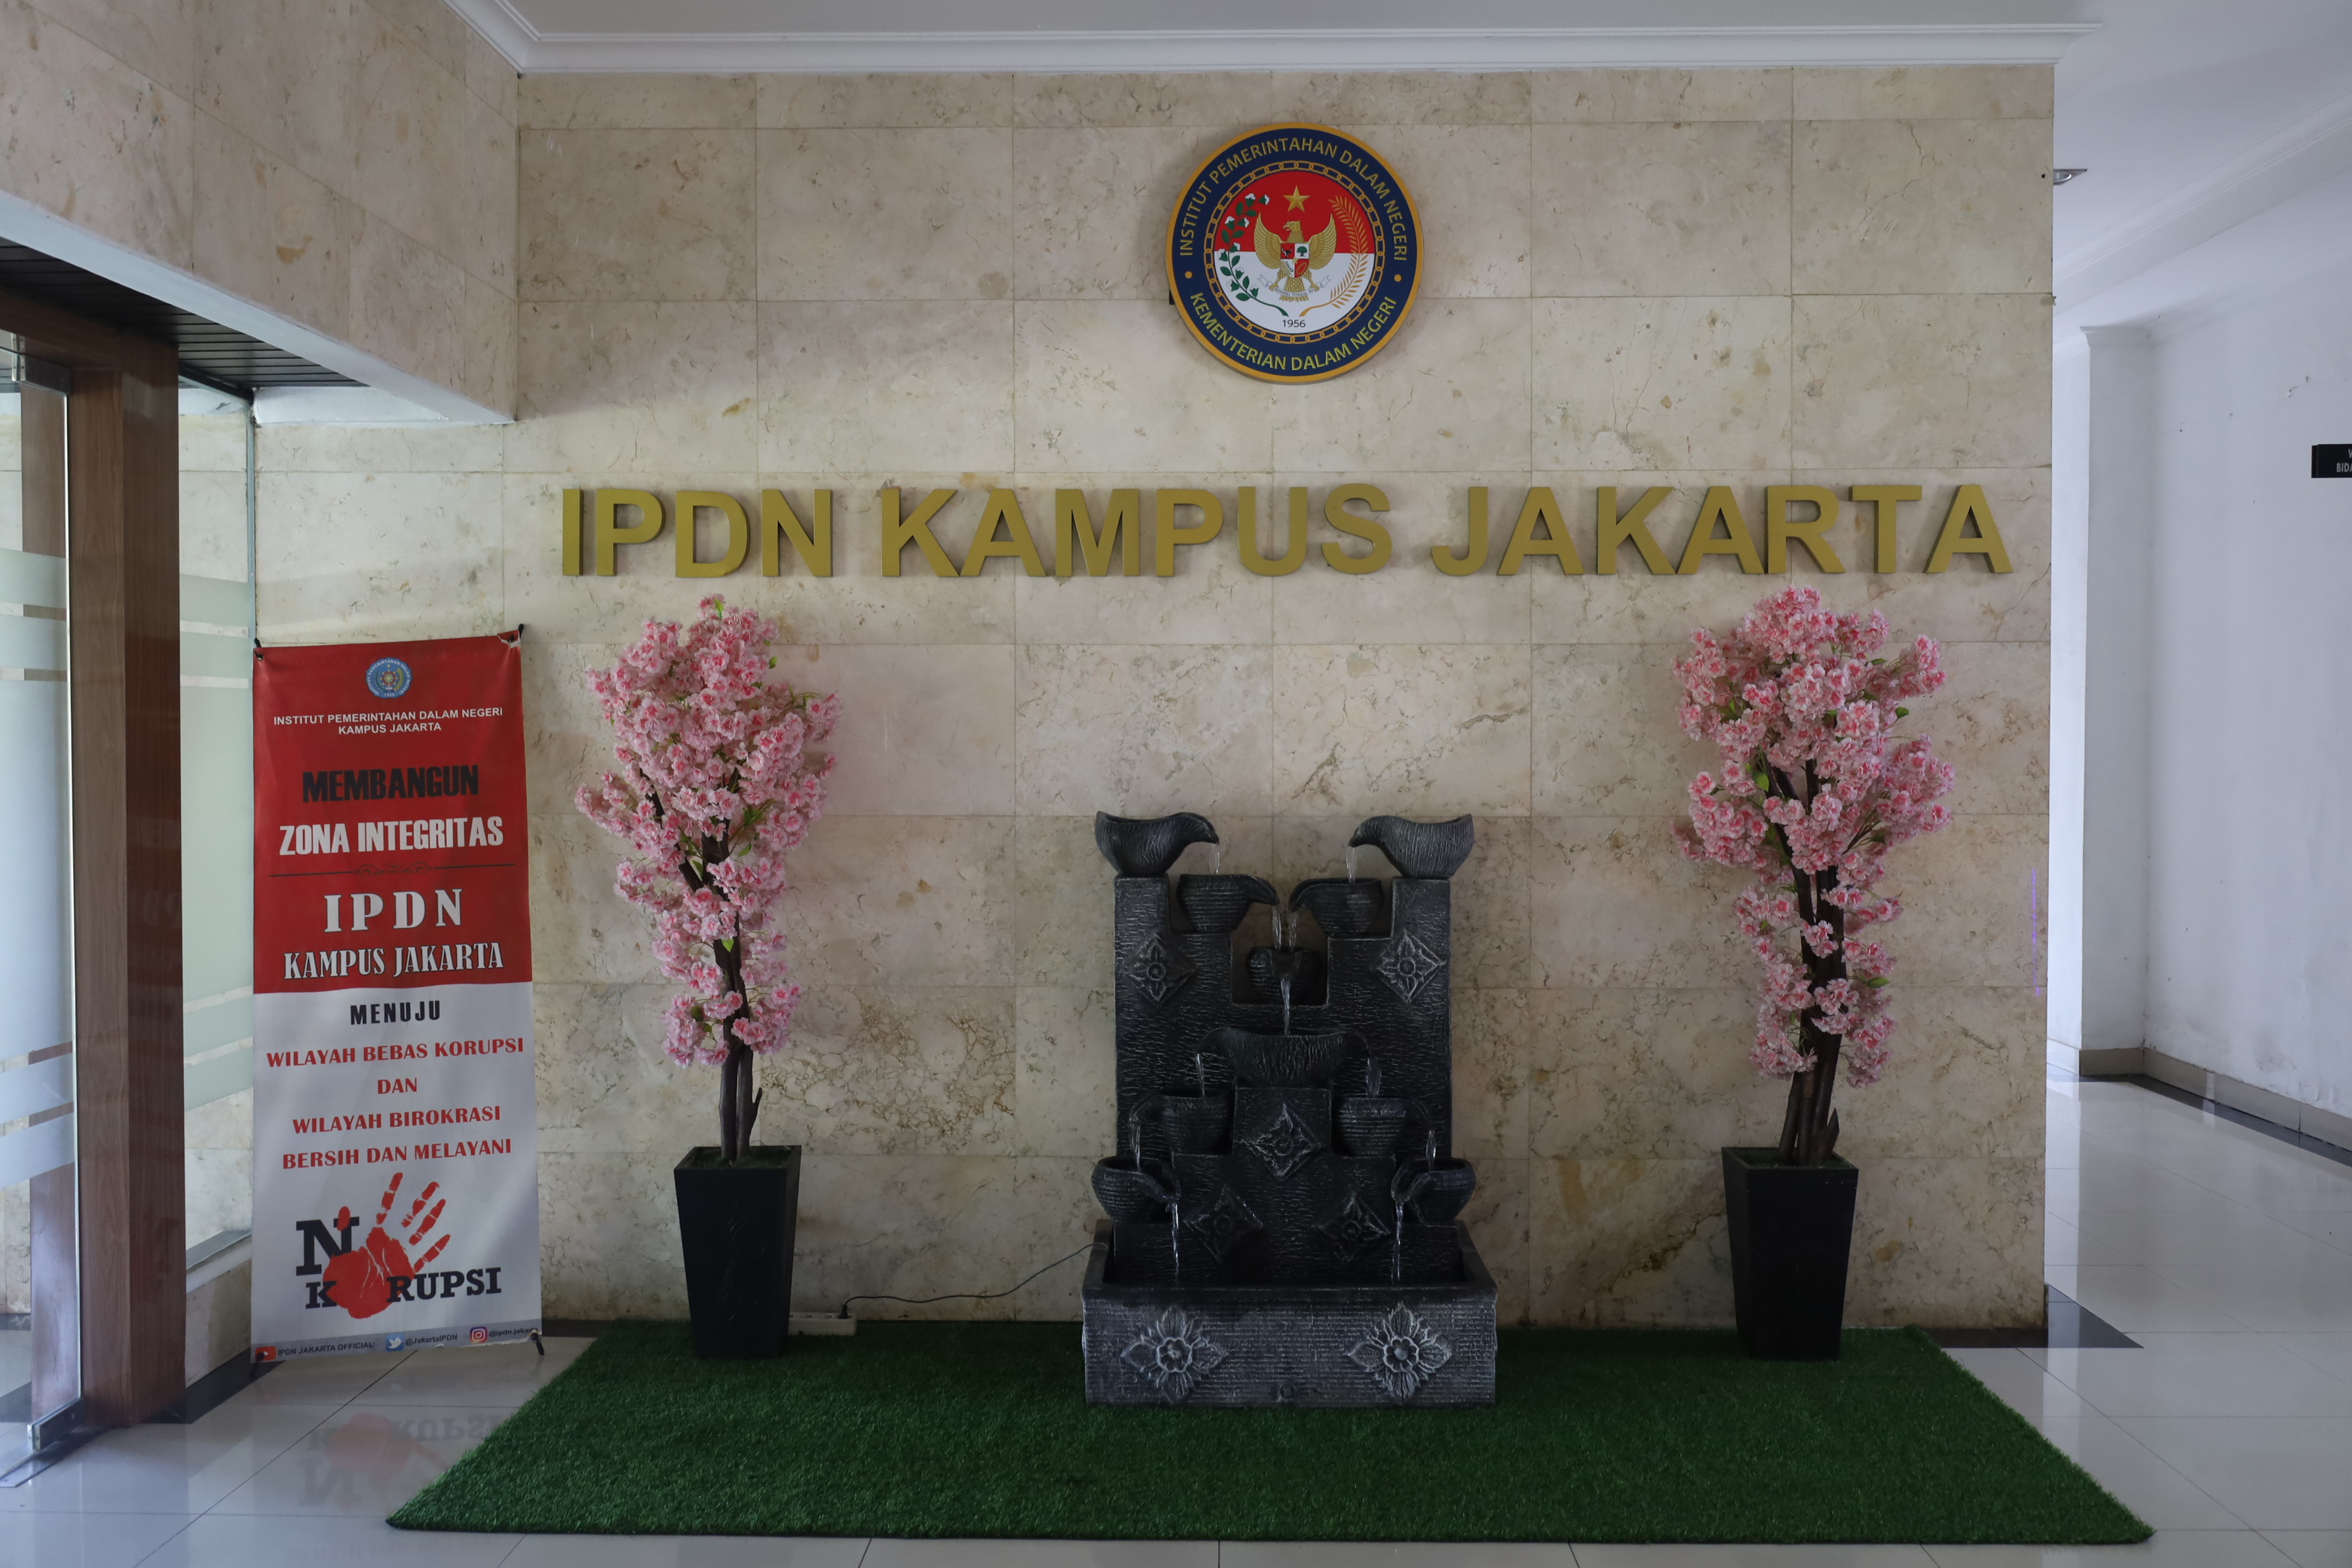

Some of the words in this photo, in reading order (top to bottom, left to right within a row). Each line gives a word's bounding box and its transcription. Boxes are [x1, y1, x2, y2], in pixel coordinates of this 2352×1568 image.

[1179, 181, 1213, 256] INSTITUT
[1208, 137, 1338, 185] PEMERINTAHAN
[1339, 149, 1391, 200] DALAM
[1383, 199, 1407, 261] NEGERI
[1190, 292, 1286, 370] KEMENTERIAN
[1291, 342, 1352, 371] DALAM
[1349, 296, 1397, 350] NEGERI
[1282, 319, 1306, 328] 1956
[562, 488, 833, 578] IPDN
[880, 483, 1394, 578] KAMPUS
[1431, 484, 2014, 577] JAKARTA
[274, 714, 325, 725] INSTITUT
[327, 711, 417, 724] PEMERINTAHAN
[419, 709, 458, 720] DALAM
[461, 707, 503, 718] NEGERI
[338, 724, 387, 735] KAMPUS
[389, 721, 442, 733] JAKARTA
[302, 764, 479, 803] MEMBANGUN
[279, 823, 350, 856] ZONA
[357, 816, 504, 853] INTEGRITAS
[323, 888, 463, 933] IPDN
[283, 948, 385, 980] KAMPUS
[393, 942, 504, 978] JAKARTA
[350, 1000, 441, 1025] MENUJU
[267, 1048, 356, 1067] WILAYAH
[363, 1043, 428, 1062] BEBAS
[434, 1037, 524, 1058] KORUPSI
[377, 1077, 418, 1095] DAN
[292, 1113, 381, 1134] WILAYAH
[390, 1105, 501, 1128] BIROKRASI
[282, 1148, 359, 1169] BERSIH
[366, 1145, 408, 1164] DAN
[414, 1138, 512, 1159] MELAYANI
[277, 1348, 297, 1356] IPDN
[299, 1345, 336, 1355] JAKARTA
[337, 1342, 374, 1352] OFFICIAL
[405, 1334, 458, 1346] @JakartaIPDN
